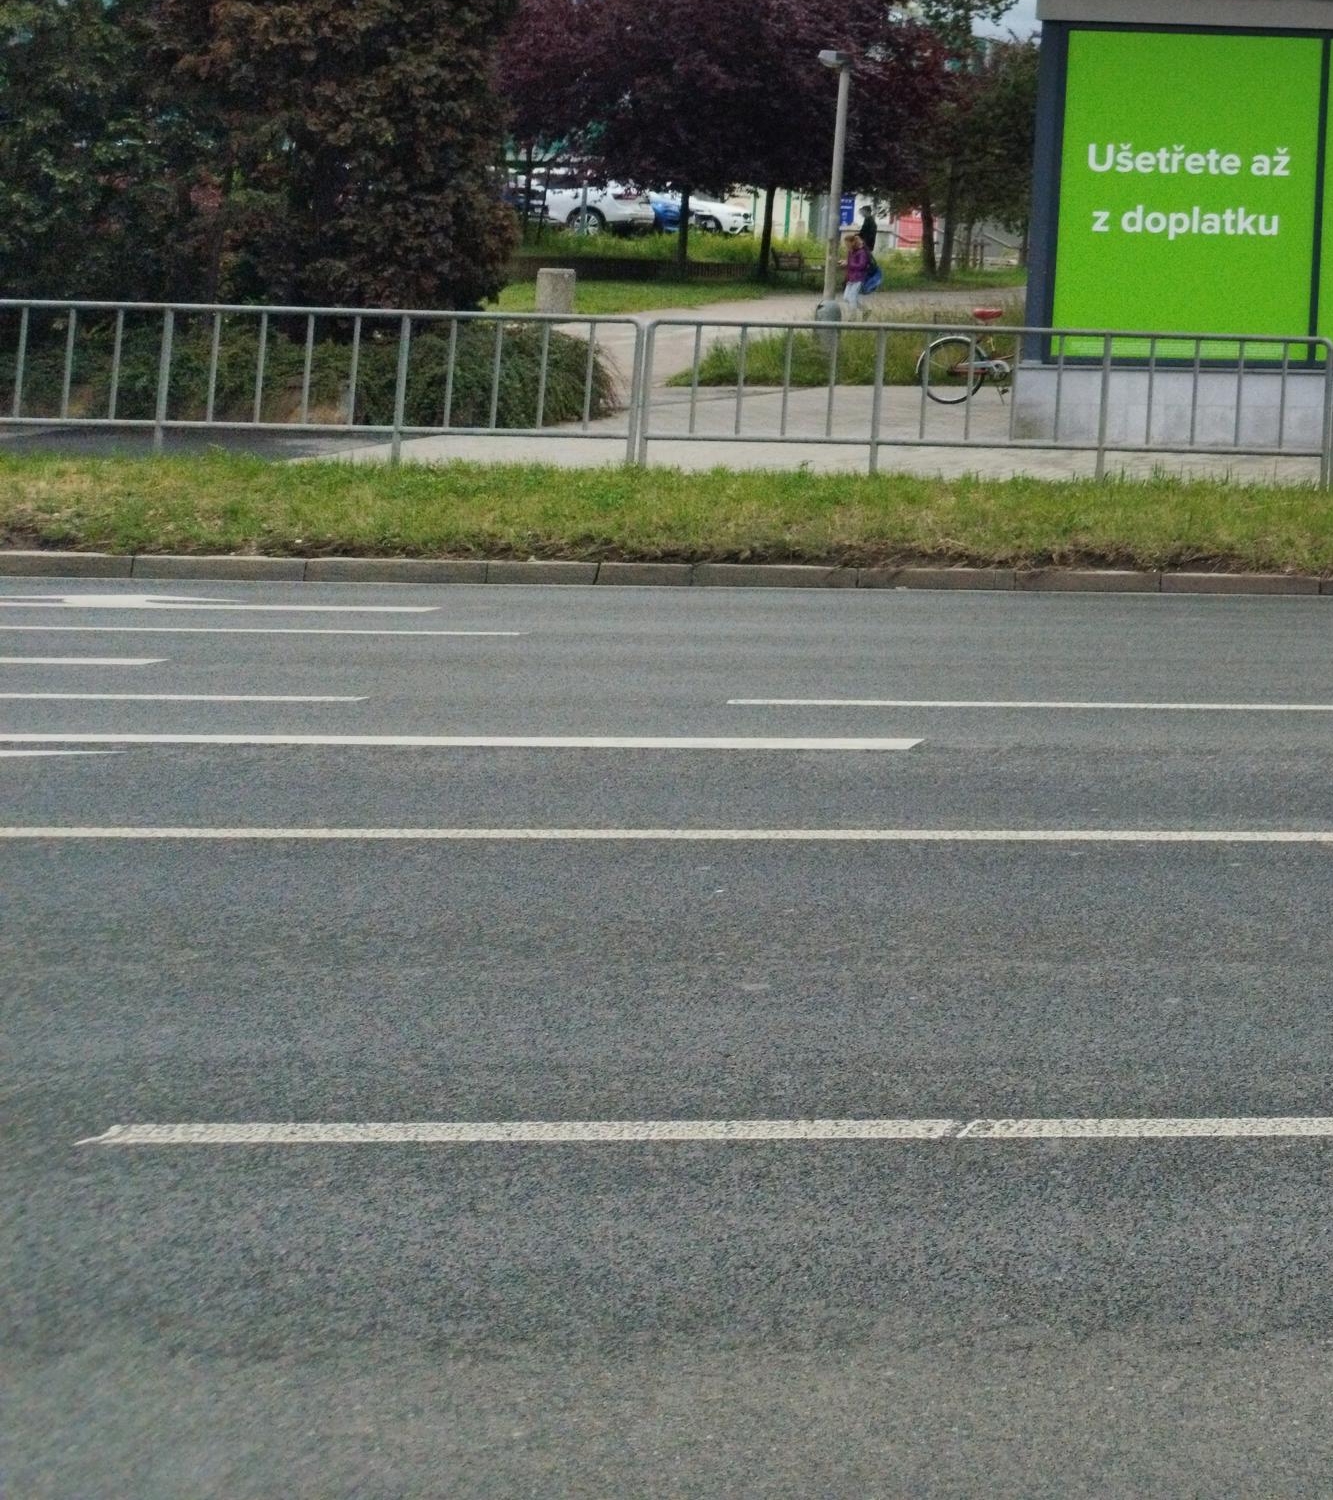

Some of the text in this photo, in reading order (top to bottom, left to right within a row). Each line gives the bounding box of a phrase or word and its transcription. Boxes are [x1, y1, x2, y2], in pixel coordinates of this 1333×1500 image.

[1087, 142, 1242, 176] Ušetřete
[1250, 147, 1291, 177] až
[1091, 210, 1111, 233] z
[1120, 204, 1280, 241] doplatku
